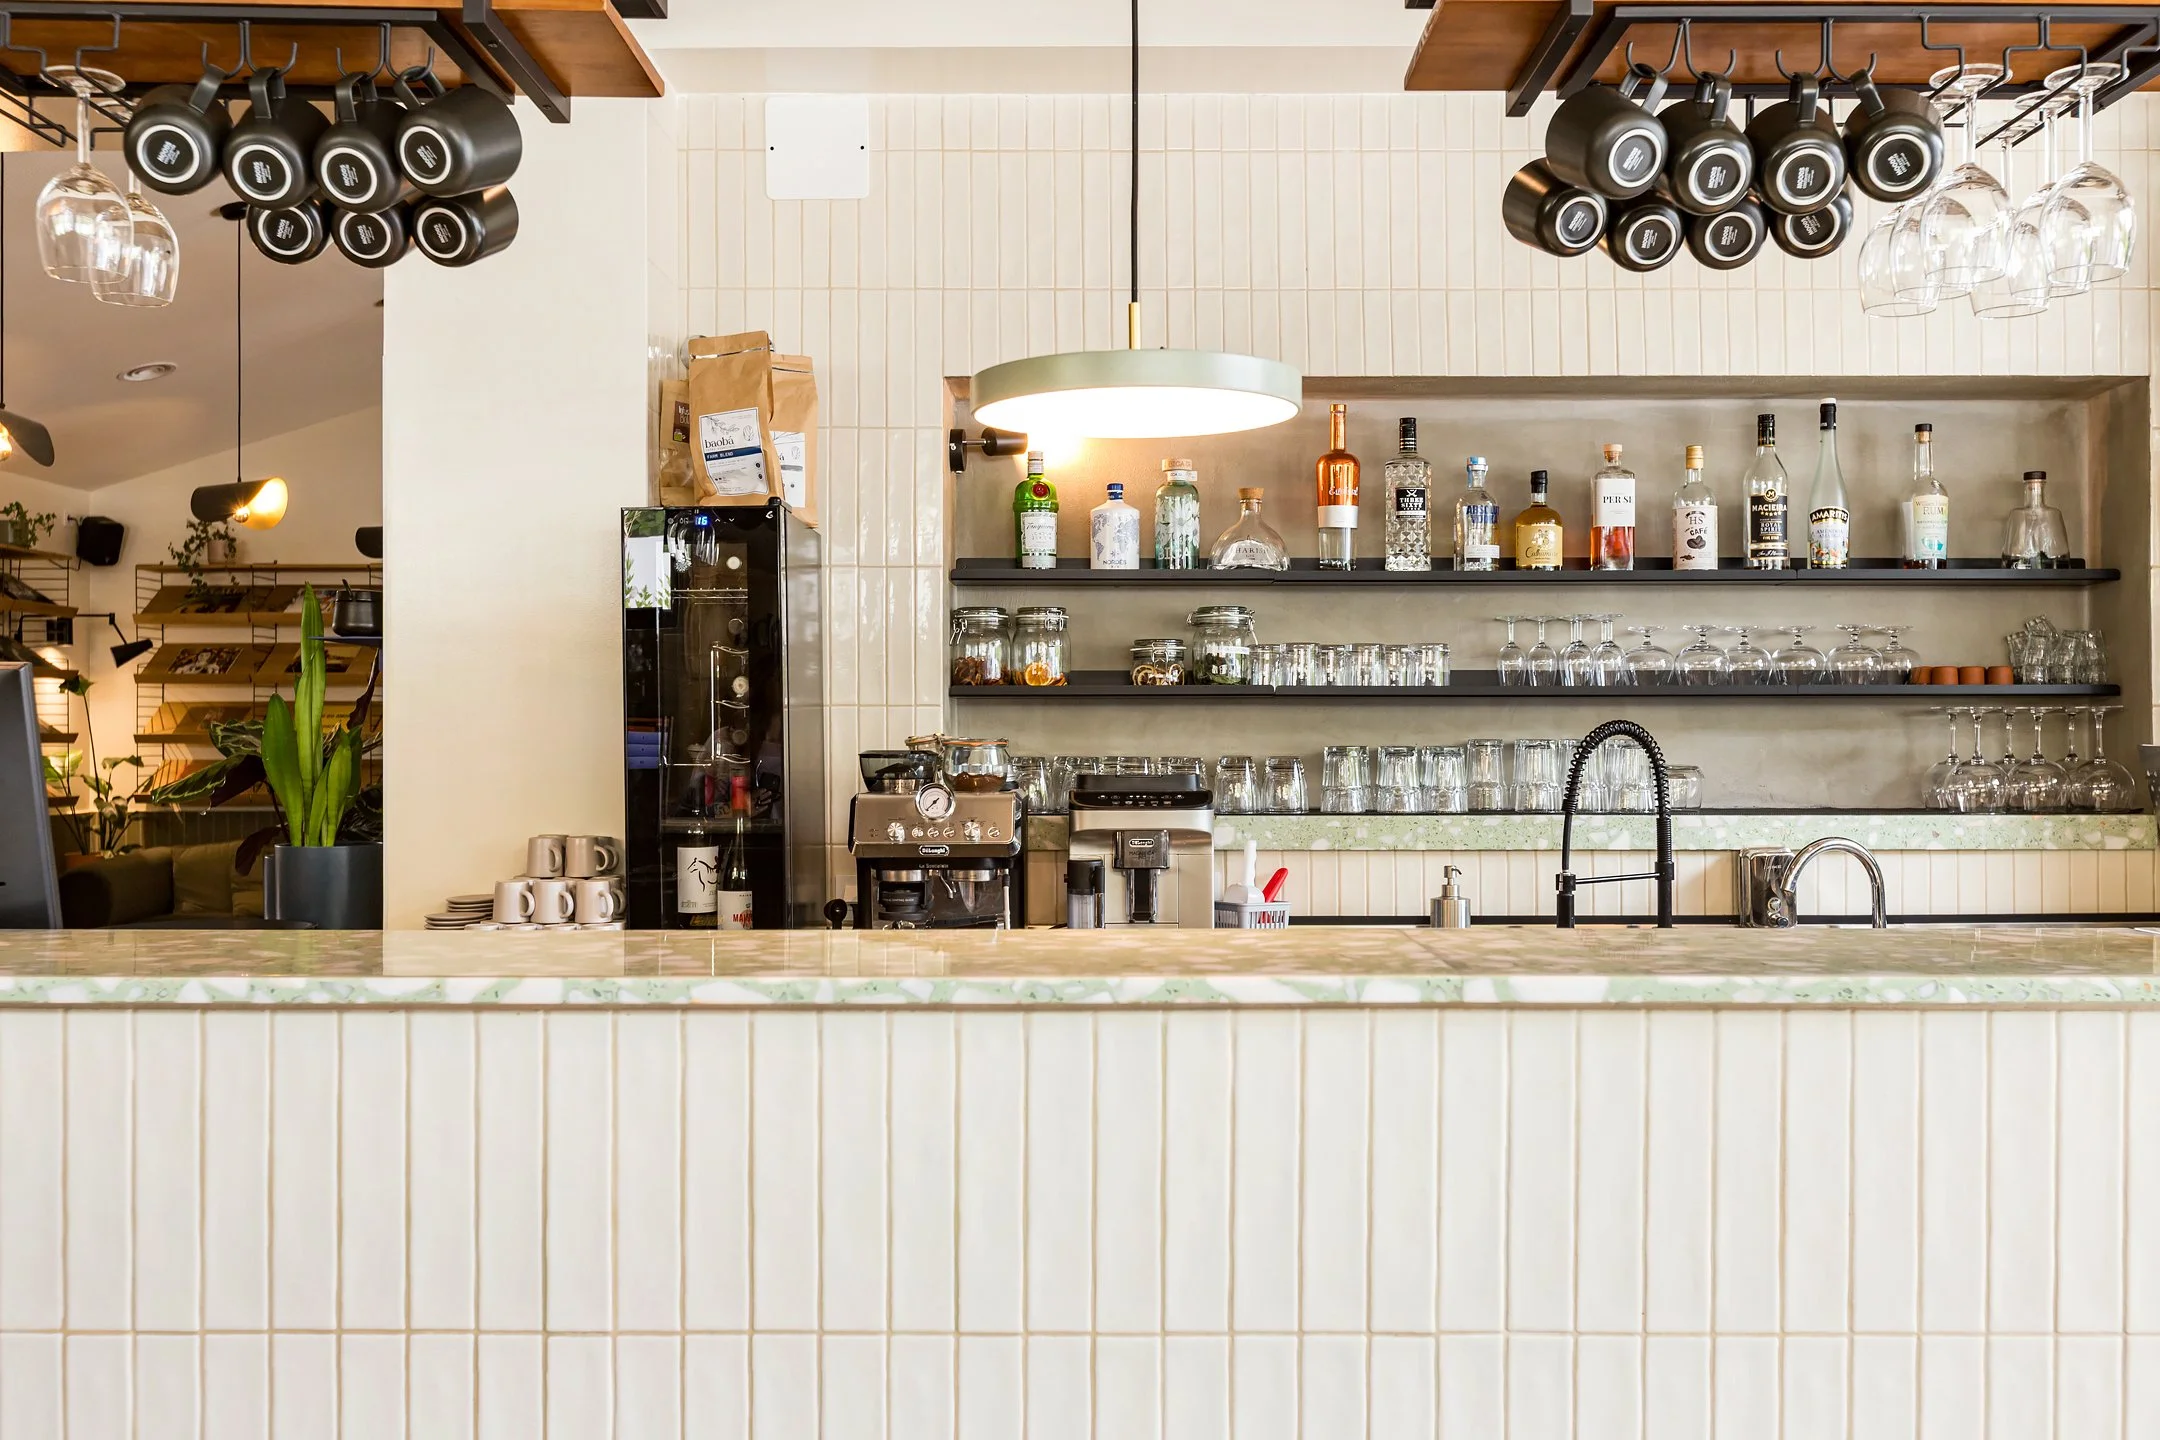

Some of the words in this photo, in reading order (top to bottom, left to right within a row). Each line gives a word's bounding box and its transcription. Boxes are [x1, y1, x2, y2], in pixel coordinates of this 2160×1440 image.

[705, 436, 734, 448] baobá
[1752, 504, 1787, 512] MACIEIRA
[1690, 526, 1708, 536] CAFÉ
